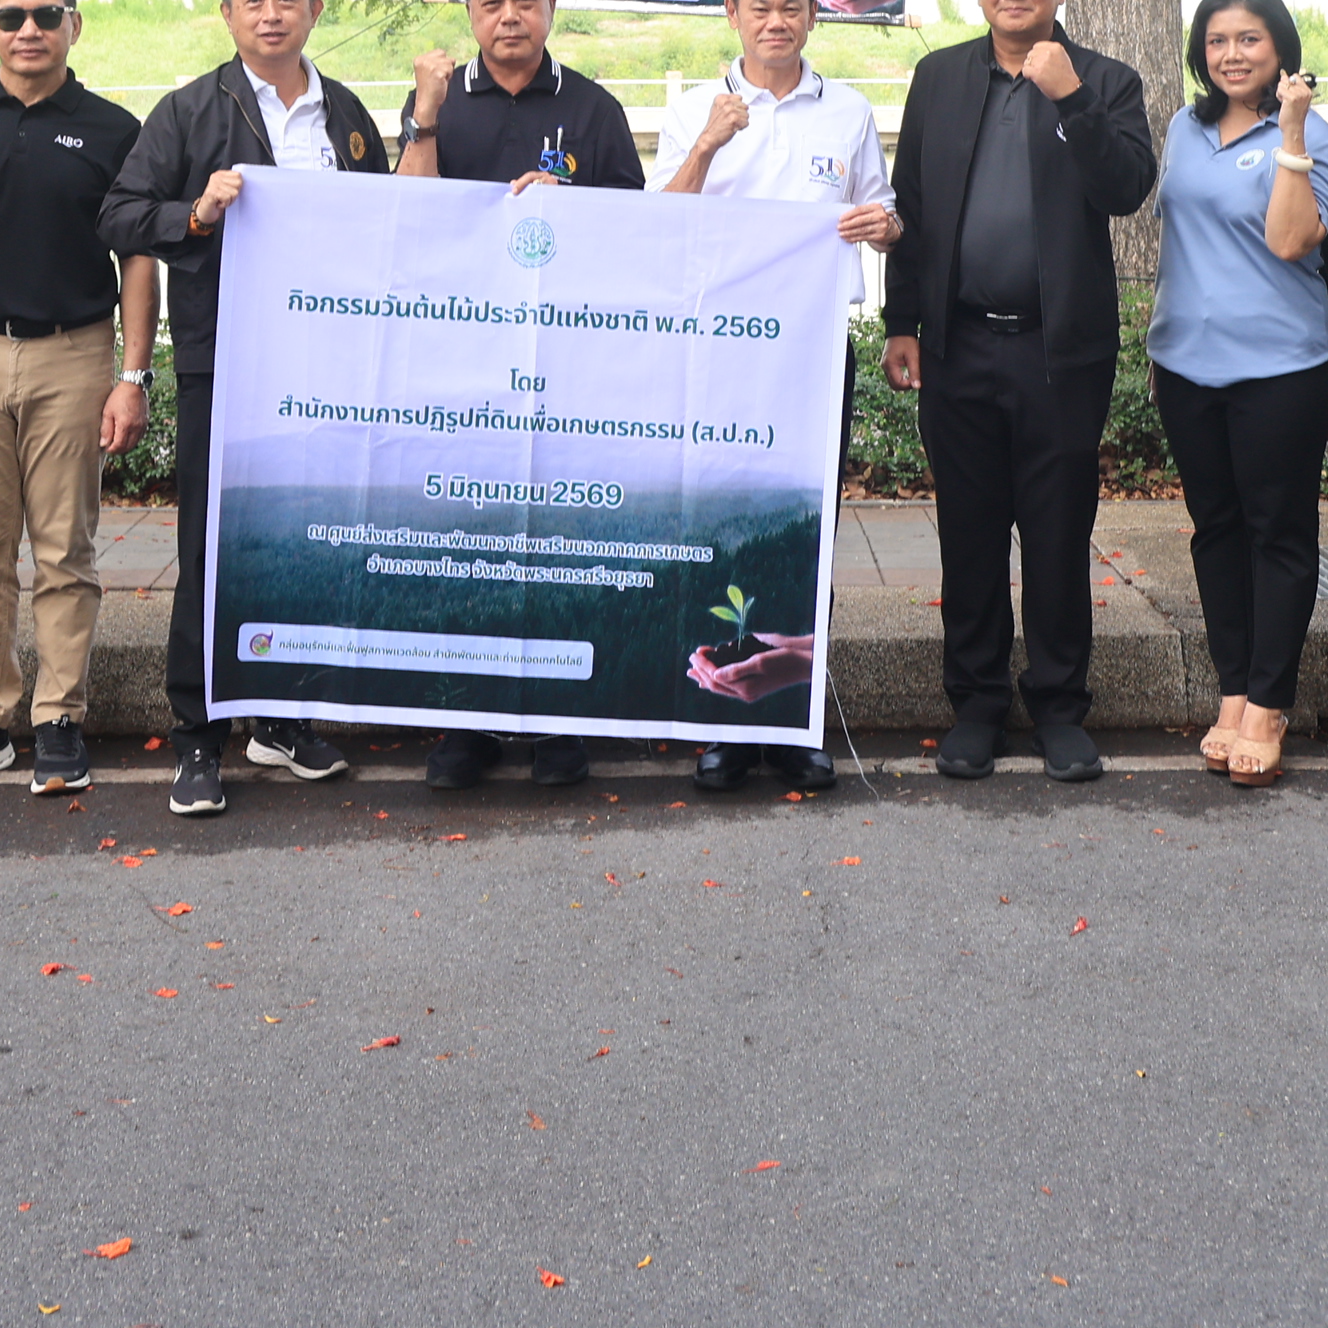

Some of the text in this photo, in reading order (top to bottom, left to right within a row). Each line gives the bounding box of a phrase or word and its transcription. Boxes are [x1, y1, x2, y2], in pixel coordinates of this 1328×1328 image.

[288, 289, 781, 339] กิจกรรมวันต้นไม้ประจำปีแห่งชาติ พ.ศ. 2569
[510, 368, 546, 392] โดย
[278, 395, 774, 448] สำนักงานการปฏิรูปที่ดินเพื่อเกษตรกรรม (ส.ป.ก.)
[424, 472, 623, 509] 5 มิถุนายน 2569
[308, 523, 714, 562] ณ ศูนย์ส่งเสริมและพัฒนาอาชีพเสริมนอกภาคการเกษตร
[367, 553, 654, 591] อำเภอบางไทร จังหวัดพระนครศรีอยุธยา
